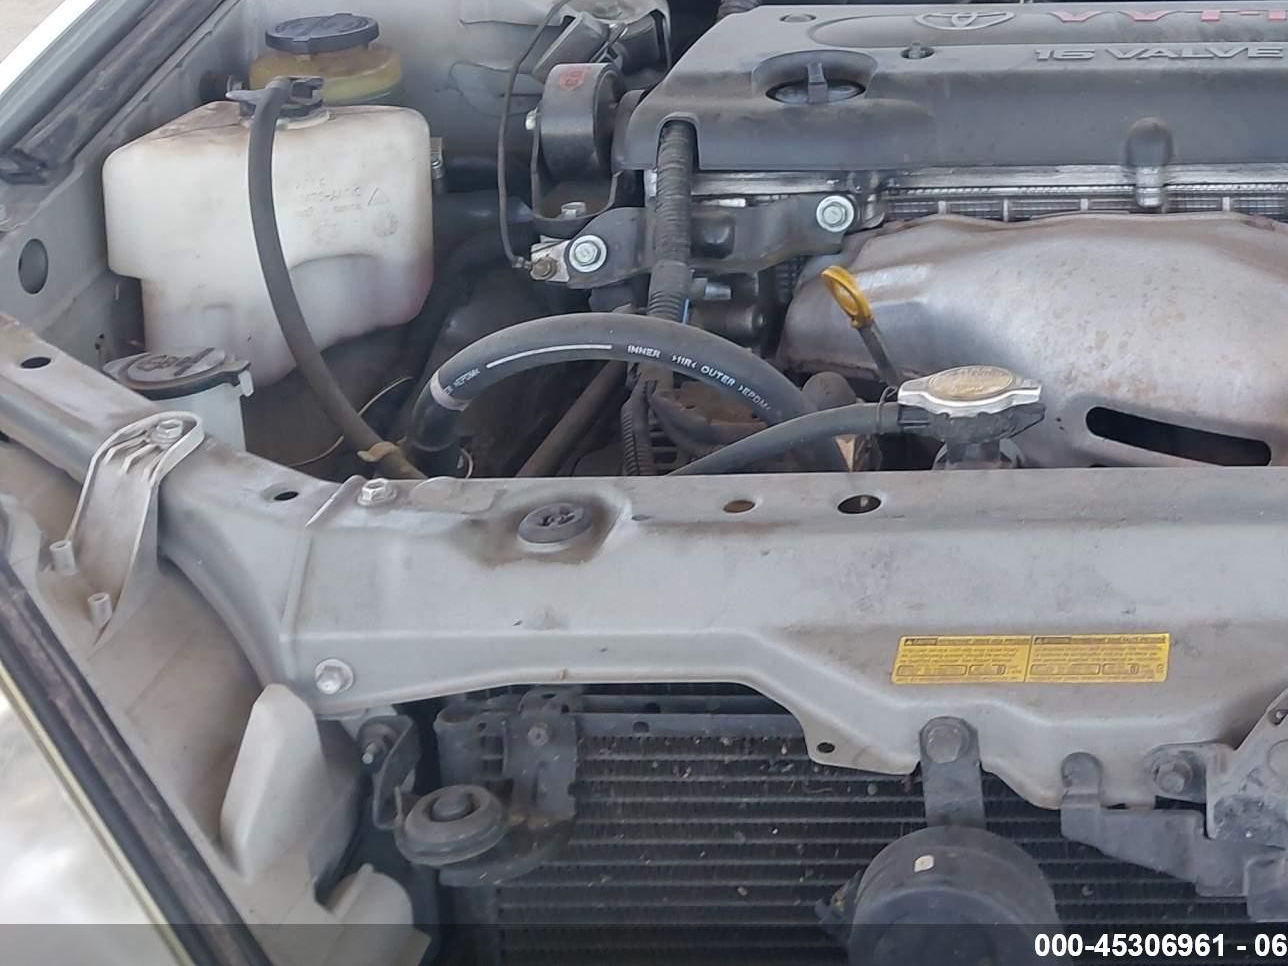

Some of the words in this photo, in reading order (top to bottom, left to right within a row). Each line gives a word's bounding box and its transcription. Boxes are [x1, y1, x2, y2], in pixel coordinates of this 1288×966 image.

[1035, 48, 1096, 61] 16
[1105, 46, 1284, 60] VALVE
[627, 344, 661, 359] INNER
[700, 365, 736, 387] OUTER
